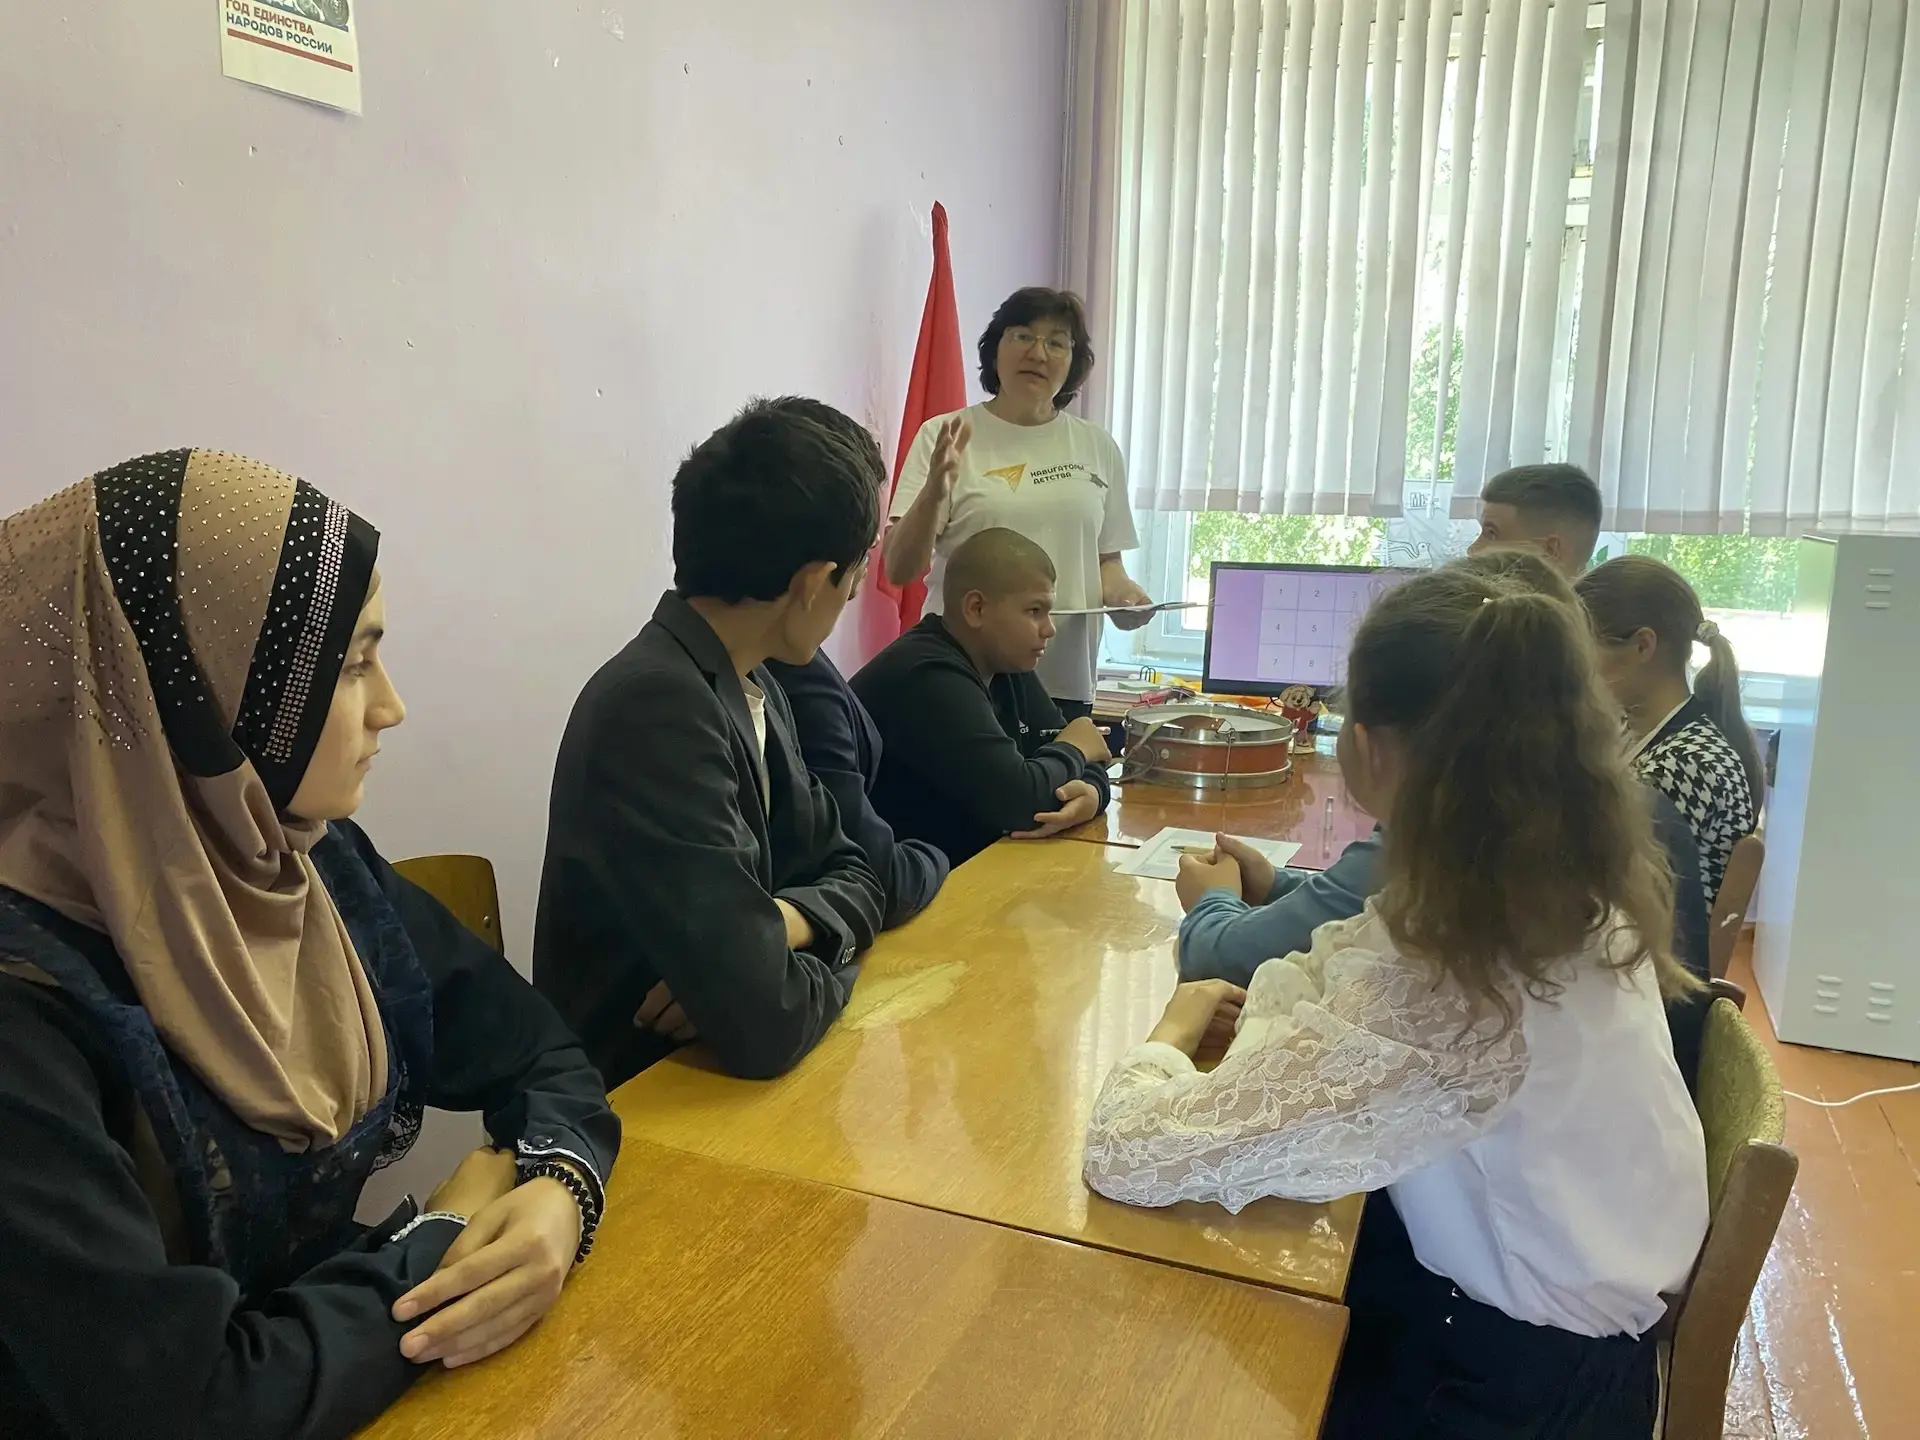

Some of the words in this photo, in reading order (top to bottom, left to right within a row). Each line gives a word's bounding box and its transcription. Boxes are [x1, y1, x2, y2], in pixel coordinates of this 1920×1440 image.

[225, 0, 250, 16] ГОД
[253, 7, 315, 36] ЕДИНСТВА
[226, 12, 283, 38] НАРОДОВ
[286, 32, 333, 54] РОССИИ
[1033, 472, 1071, 484] ДЕТСТВА
